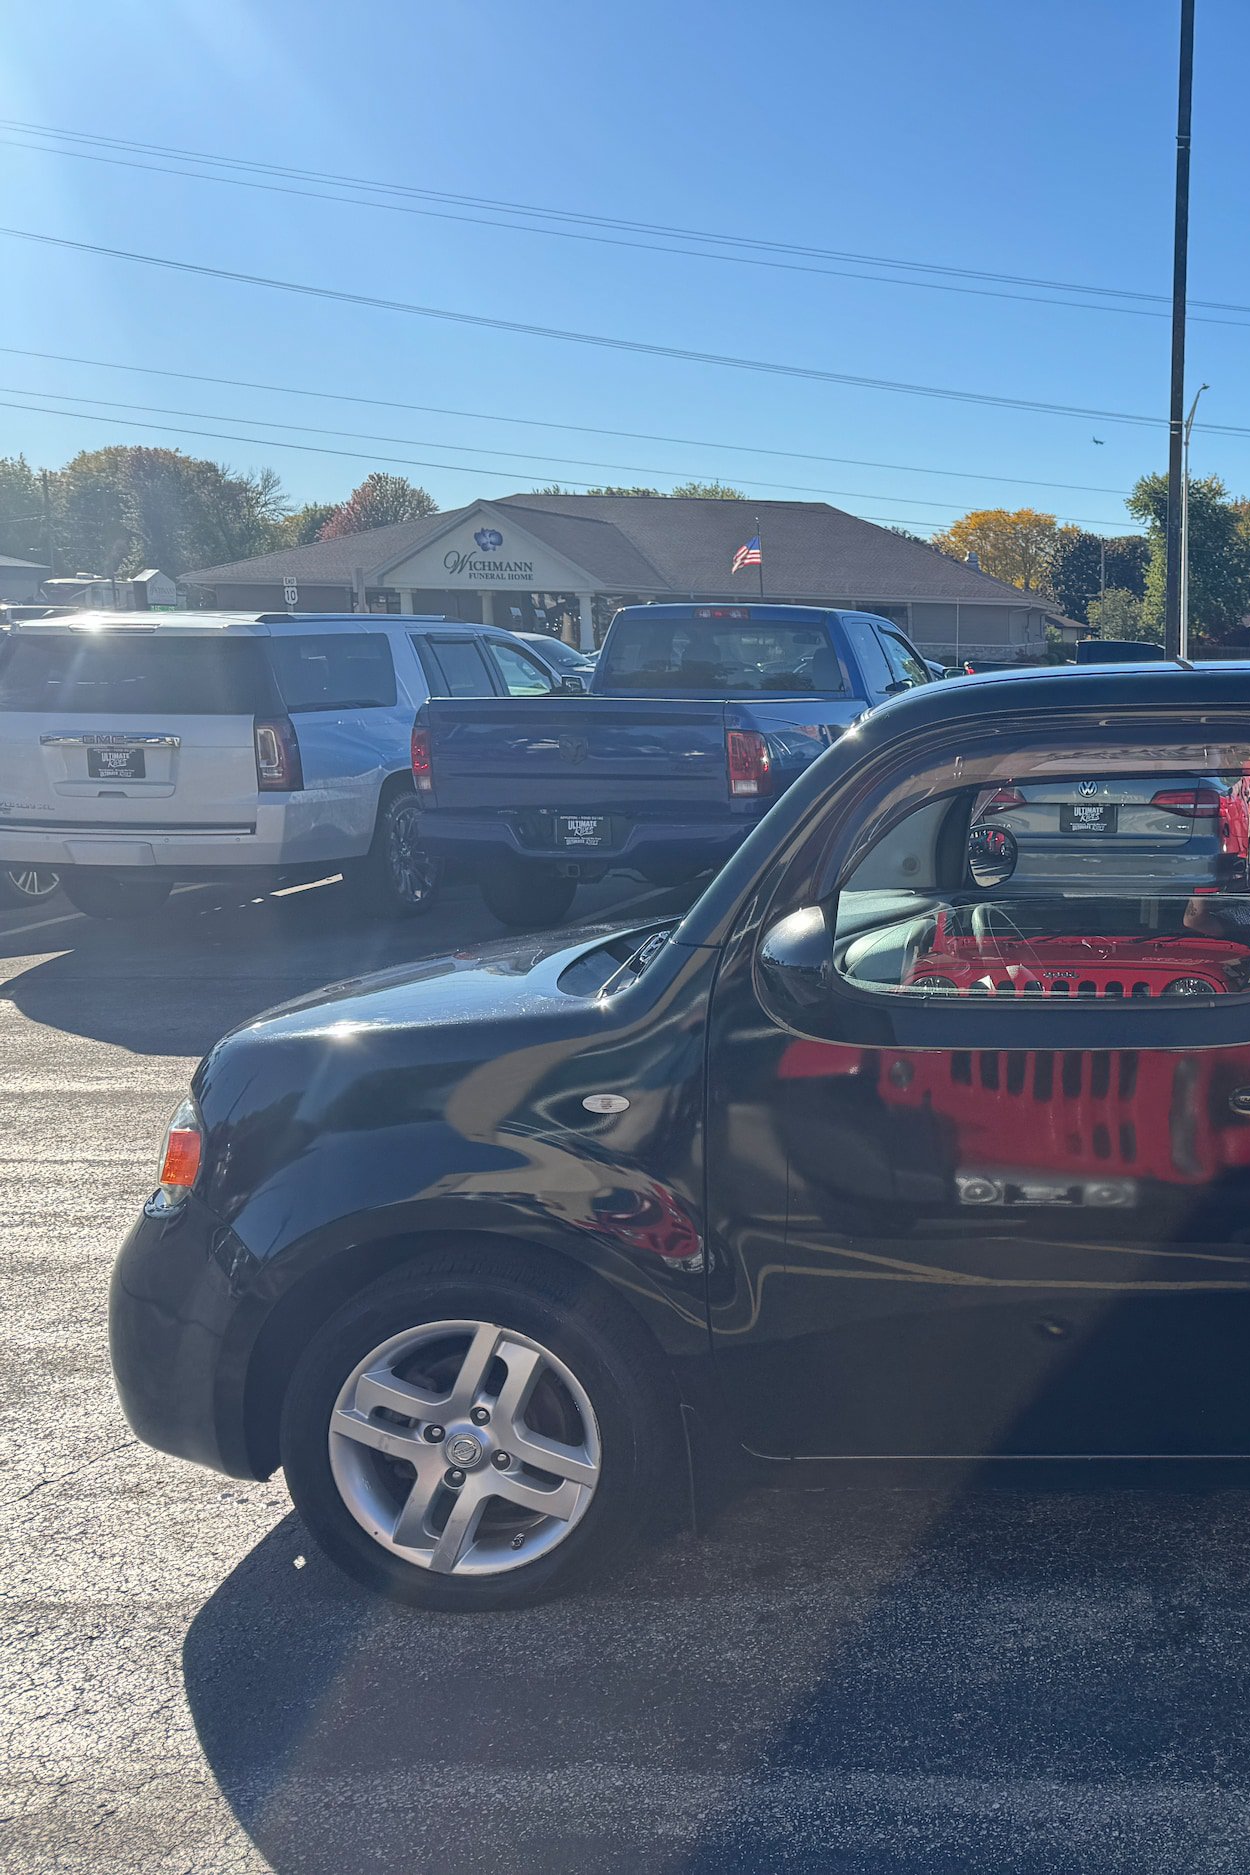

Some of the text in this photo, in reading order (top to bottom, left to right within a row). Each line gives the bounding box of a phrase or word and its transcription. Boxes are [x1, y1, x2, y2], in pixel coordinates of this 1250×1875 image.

[468, 572, 534, 581] FUNERAL HOME
[286, 590, 296, 601] 10
[83, 735, 127, 744] GMC
[101, 752, 130, 762] ULTIMATE
[1073, 806, 1104, 817] ULTIMATE
[567, 820, 598, 831] ULTIMATE
